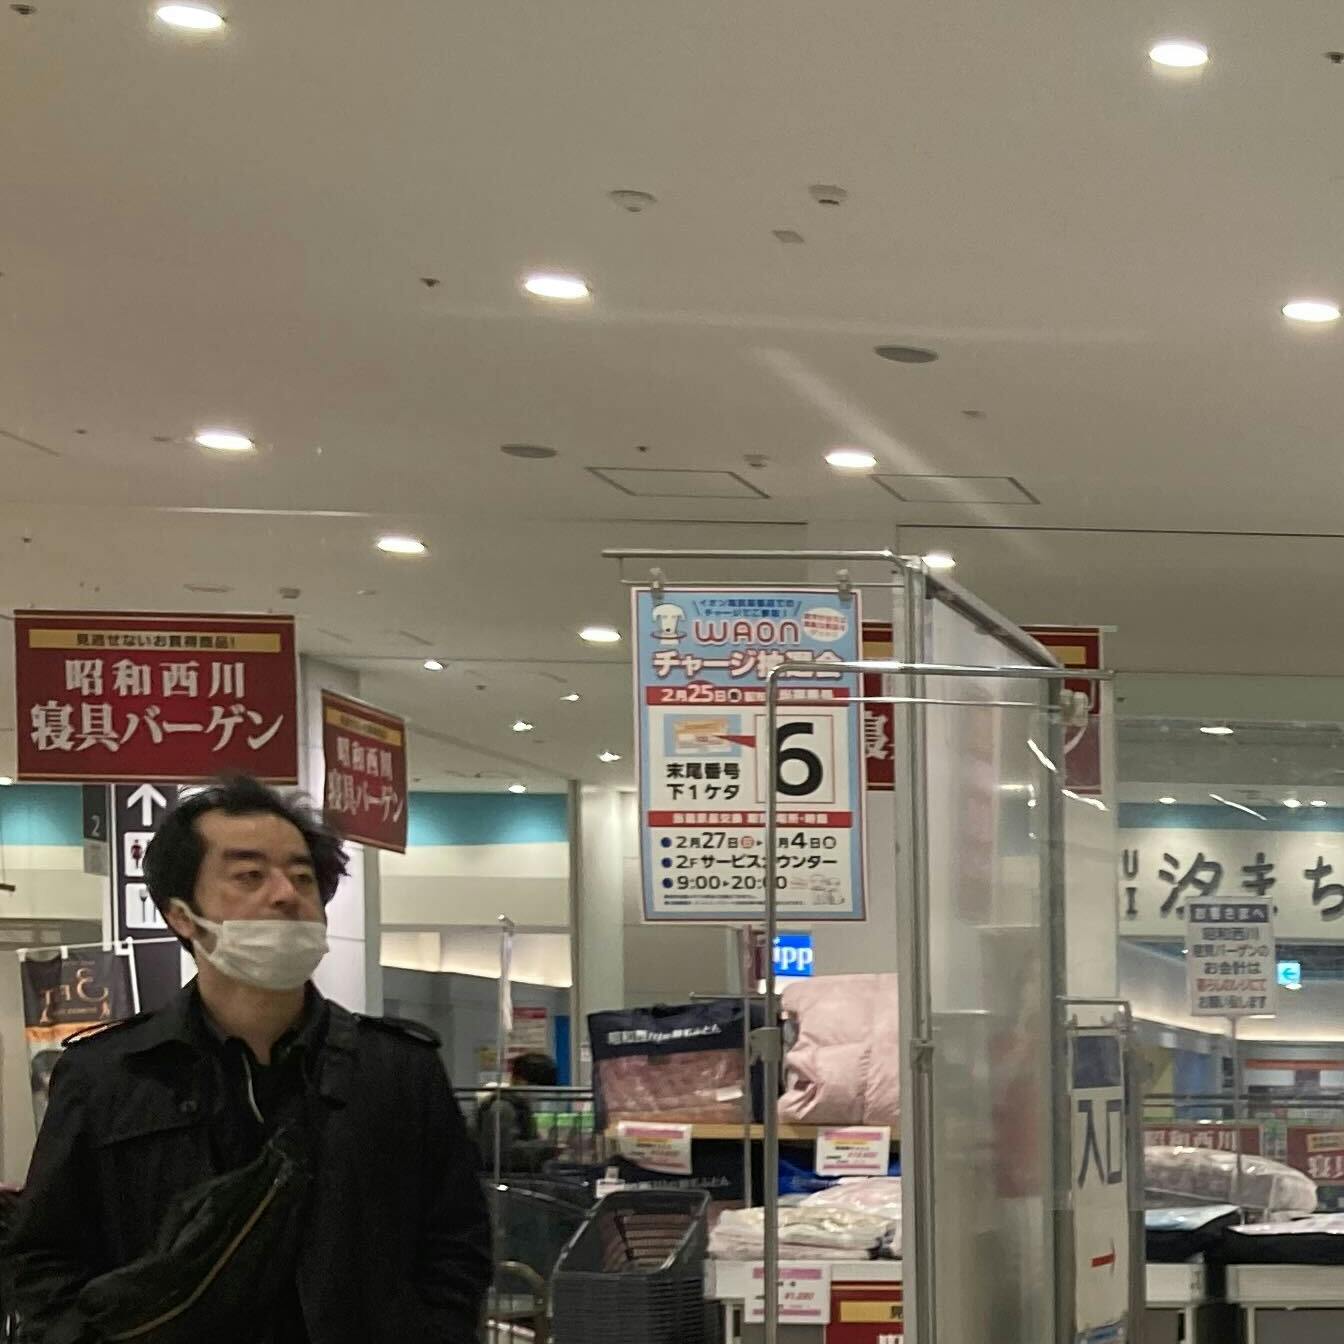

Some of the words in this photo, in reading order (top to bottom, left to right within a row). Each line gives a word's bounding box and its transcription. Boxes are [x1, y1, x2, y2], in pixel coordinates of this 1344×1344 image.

[694, 620, 800, 644] WAON
[65, 658, 245, 699] 昭和西川
[30, 699, 284, 752] 寝具バーゲン
[667, 762, 740, 780] 末尾番号
[772, 721, 824, 797] 6
[676, 854, 838, 869] 2Fサービスウンター
